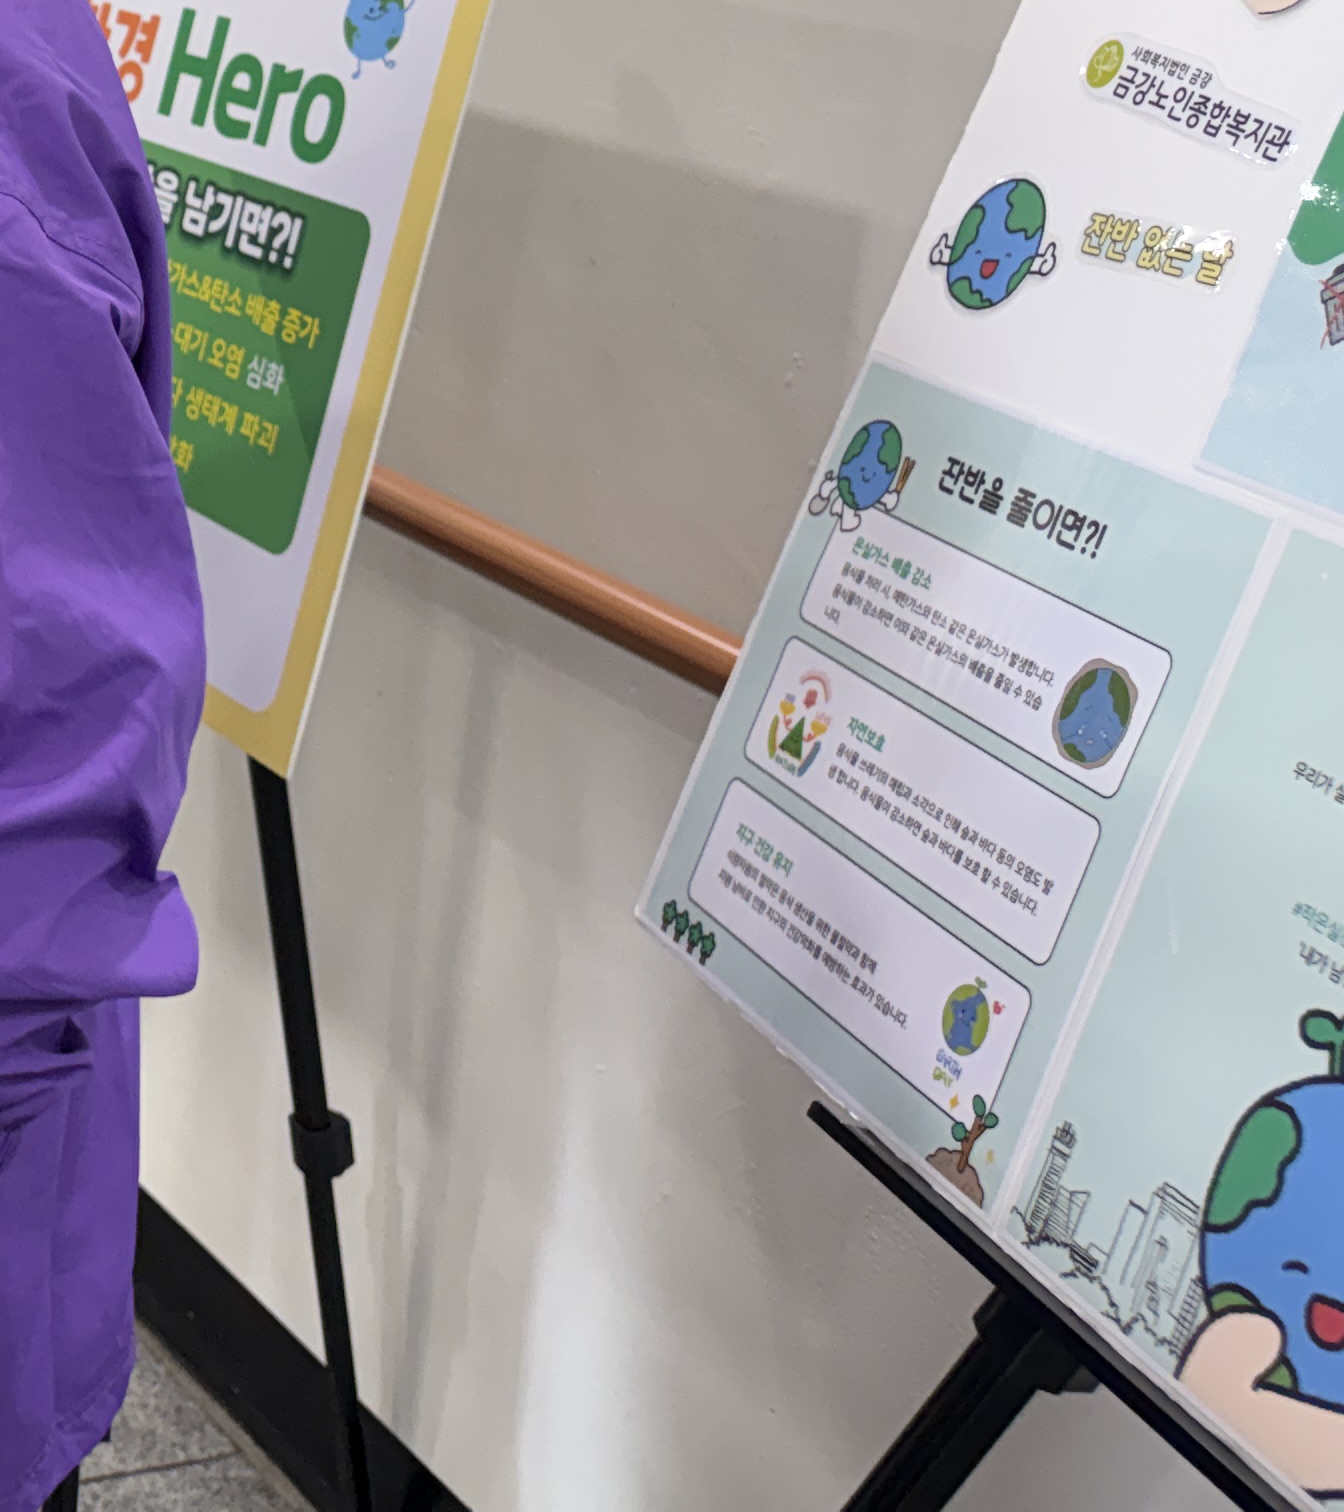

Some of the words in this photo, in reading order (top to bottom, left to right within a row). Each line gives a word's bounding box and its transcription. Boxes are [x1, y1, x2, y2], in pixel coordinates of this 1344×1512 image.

[158, 7, 345, 164] Hero
[1131, 46, 1190, 81] 사회복지법인
[1190, 67, 1213, 89] 금강
[1112, 65, 1292, 162] 금강노인종합복지관
[148, 164, 179, 225] 을
[182, 178, 303, 270] 남기면?!
[1081, 212, 1140, 263] 잔반
[1136, 225, 1194, 278] 없는
[168, 258, 243, 317] 가스&탄소
[245, 293, 281, 336] 배출
[281, 308, 320, 349] 증가
[208, 338, 246, 380] 오염
[246, 354, 285, 396] 심화
[186, 386, 239, 437] 생태계
[240, 412, 279, 456] 파괴
[938, 456, 1004, 516] 잔반을
[1006, 487, 1108, 559] 줄이면?!
[1293, 761, 1335, 796] 우리가
